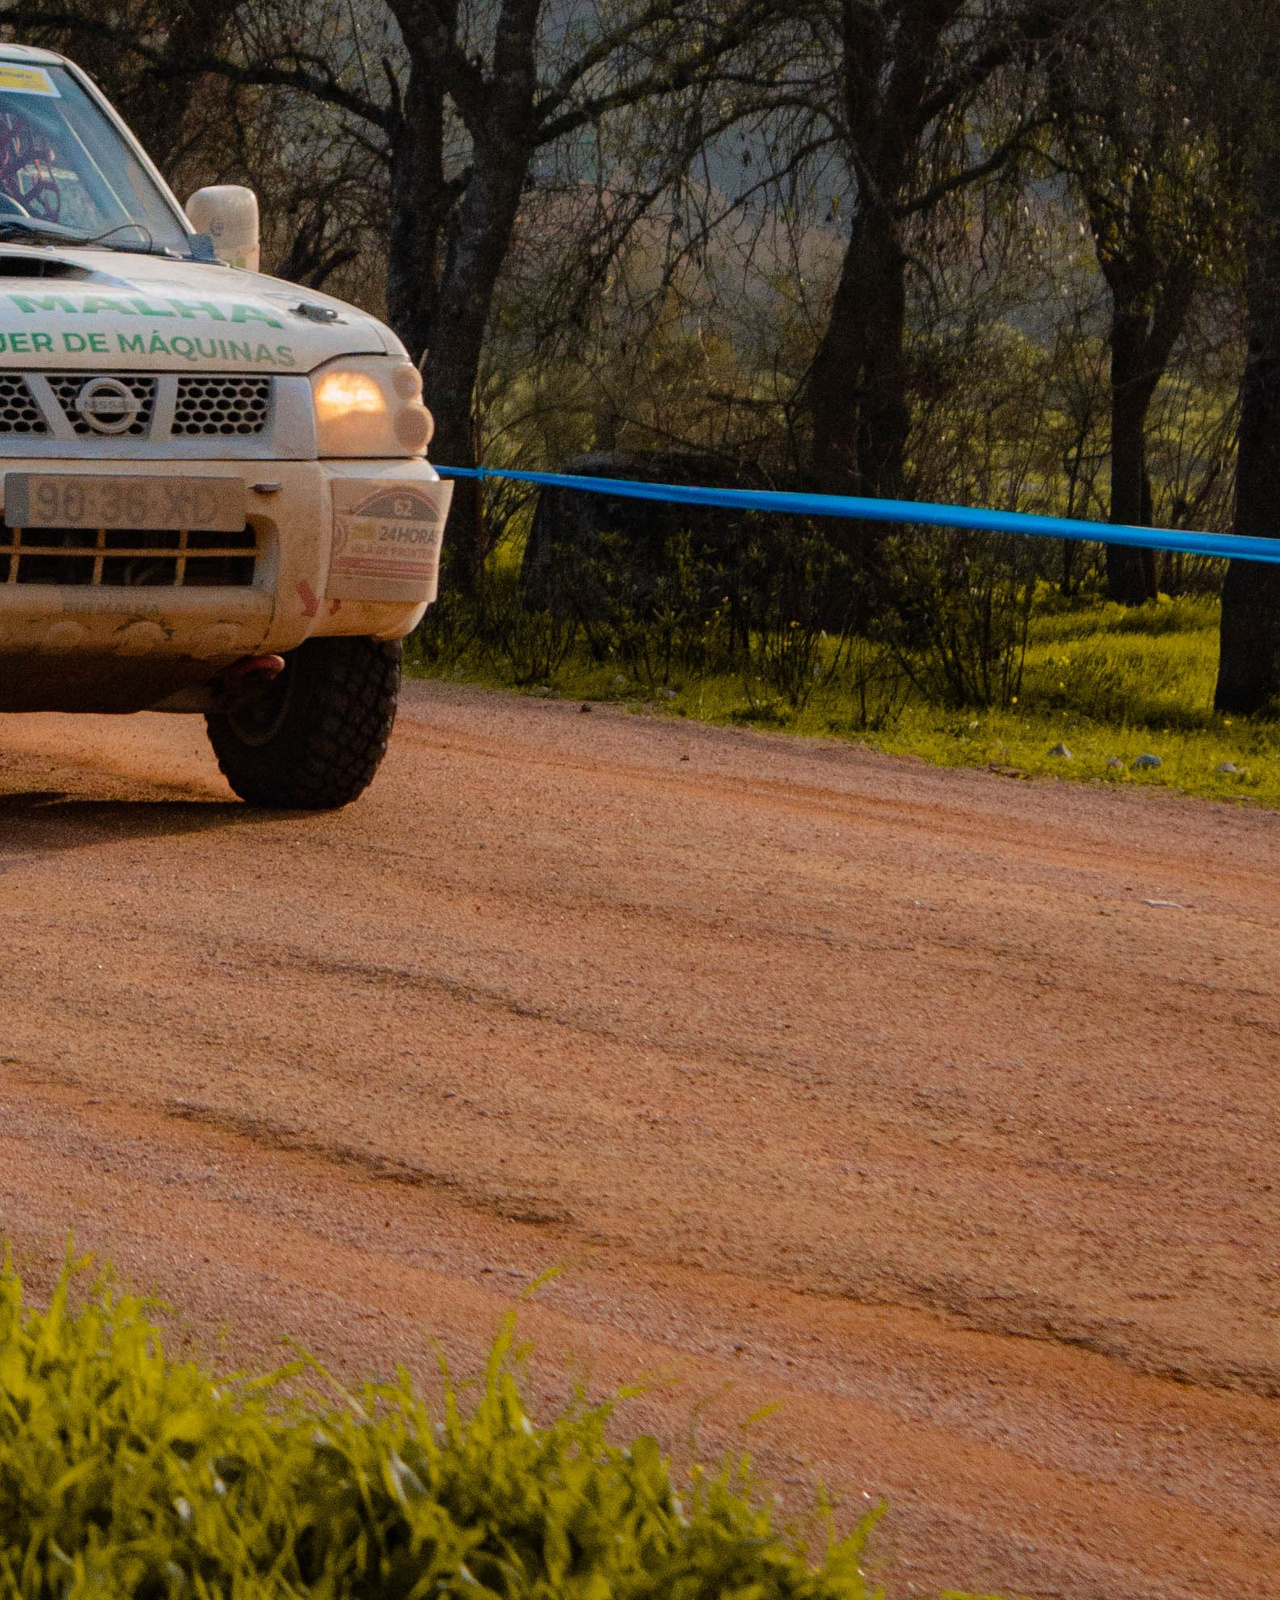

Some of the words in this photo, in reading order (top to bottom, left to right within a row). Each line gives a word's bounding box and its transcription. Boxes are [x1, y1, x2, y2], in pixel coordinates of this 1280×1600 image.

[7, 292, 284, 329] MALHA
[62, 331, 111, 353] DE
[117, 330, 296, 367] MÁQUINAS
[393, 499, 413, 518] 62
